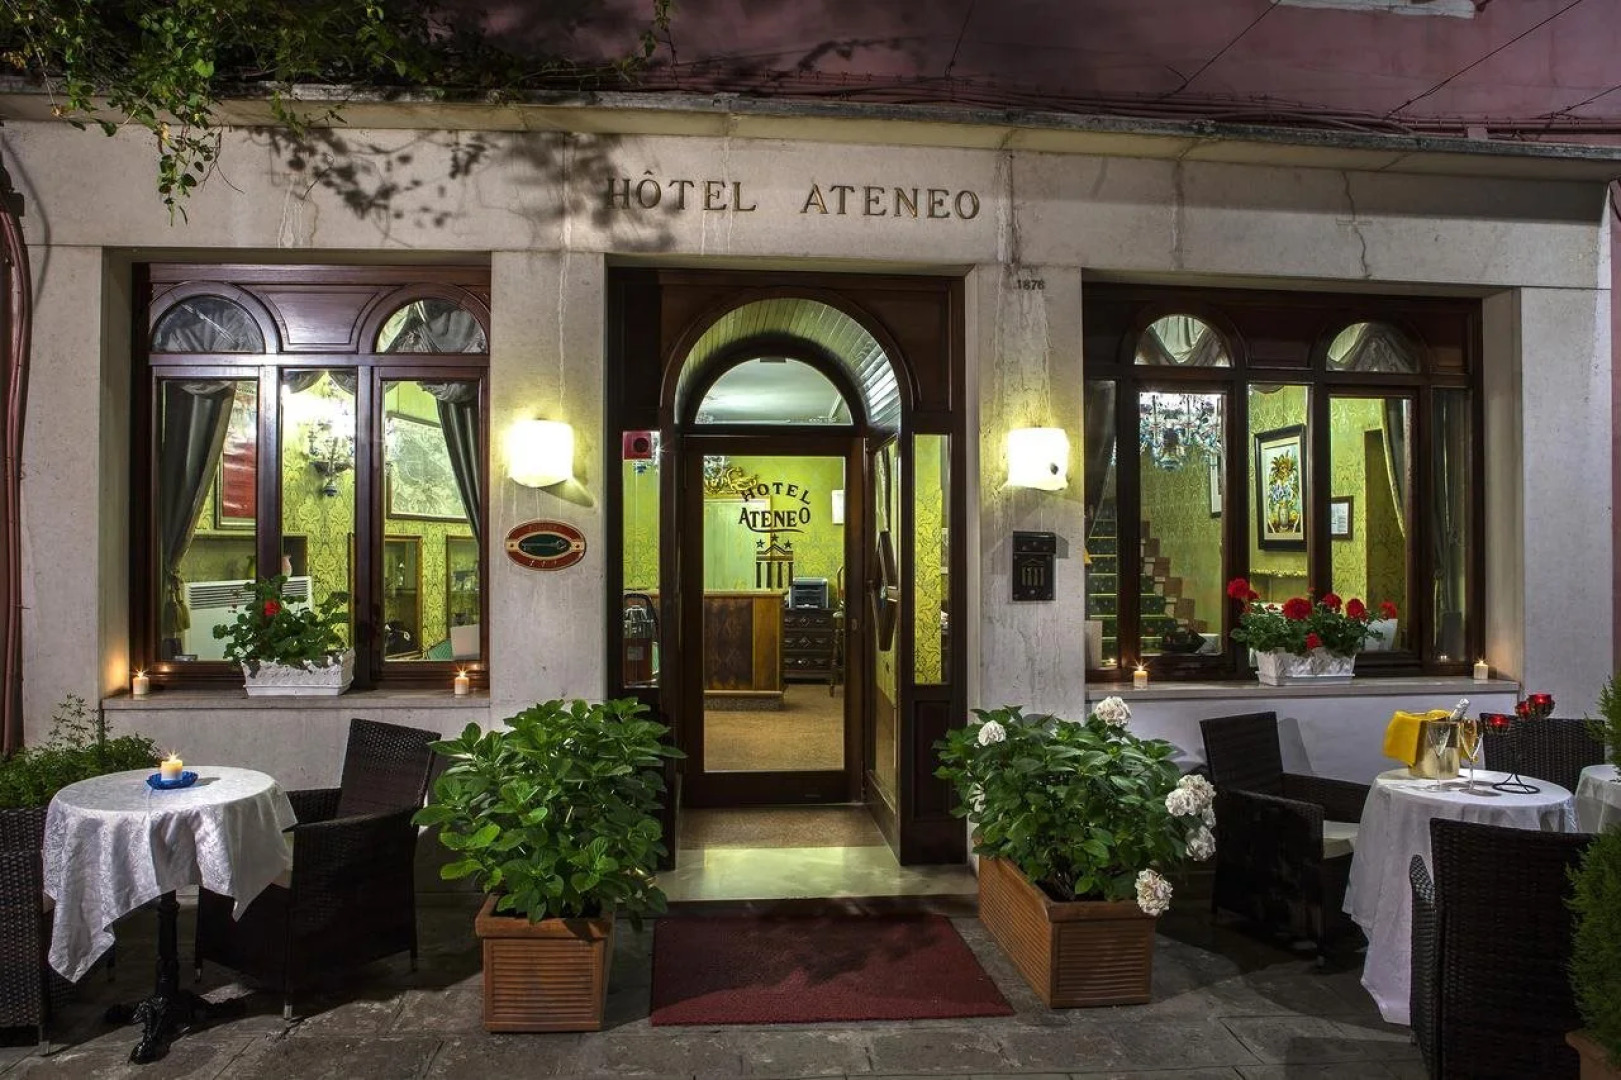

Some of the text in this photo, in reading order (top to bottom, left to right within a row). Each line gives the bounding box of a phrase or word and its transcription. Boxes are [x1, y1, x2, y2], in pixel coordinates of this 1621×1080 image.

[606, 170, 981, 221] HÔTEL ATENEO
[740, 482, 811, 505] HOTEL
[738, 507, 811, 533] ATENEO
